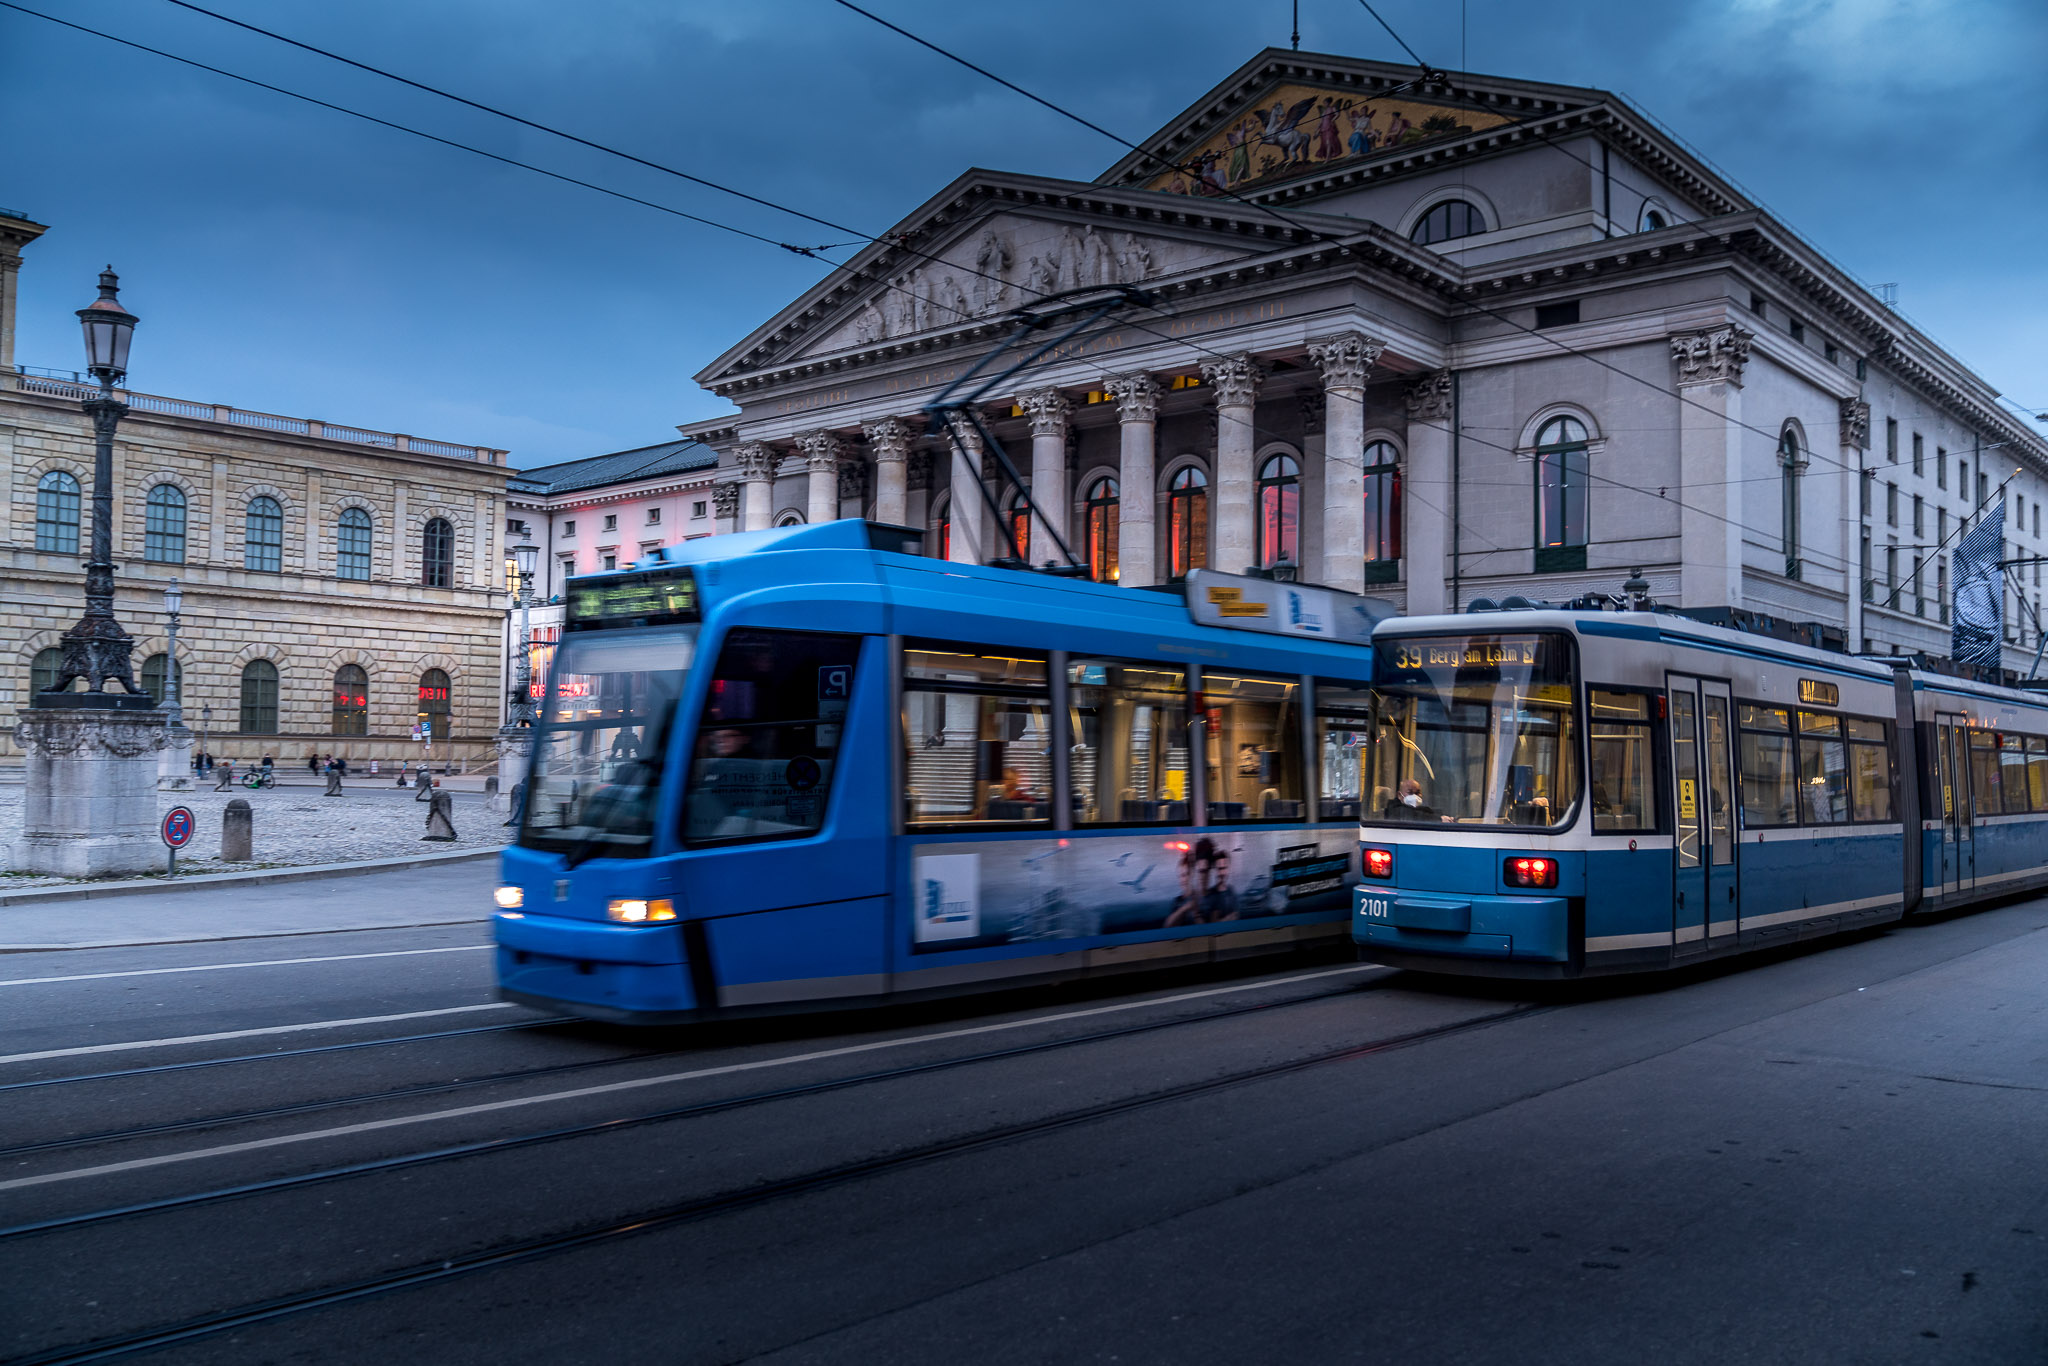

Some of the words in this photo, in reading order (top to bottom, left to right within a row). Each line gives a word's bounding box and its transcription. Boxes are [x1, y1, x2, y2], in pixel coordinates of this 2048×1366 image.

[1395, 645, 1423, 669] 39
[1429, 647, 1460, 668] Berg
[1464, 649, 1481, 664] am
[1486, 645, 1518, 663] Laim
[1359, 897, 1388, 918] 2101
